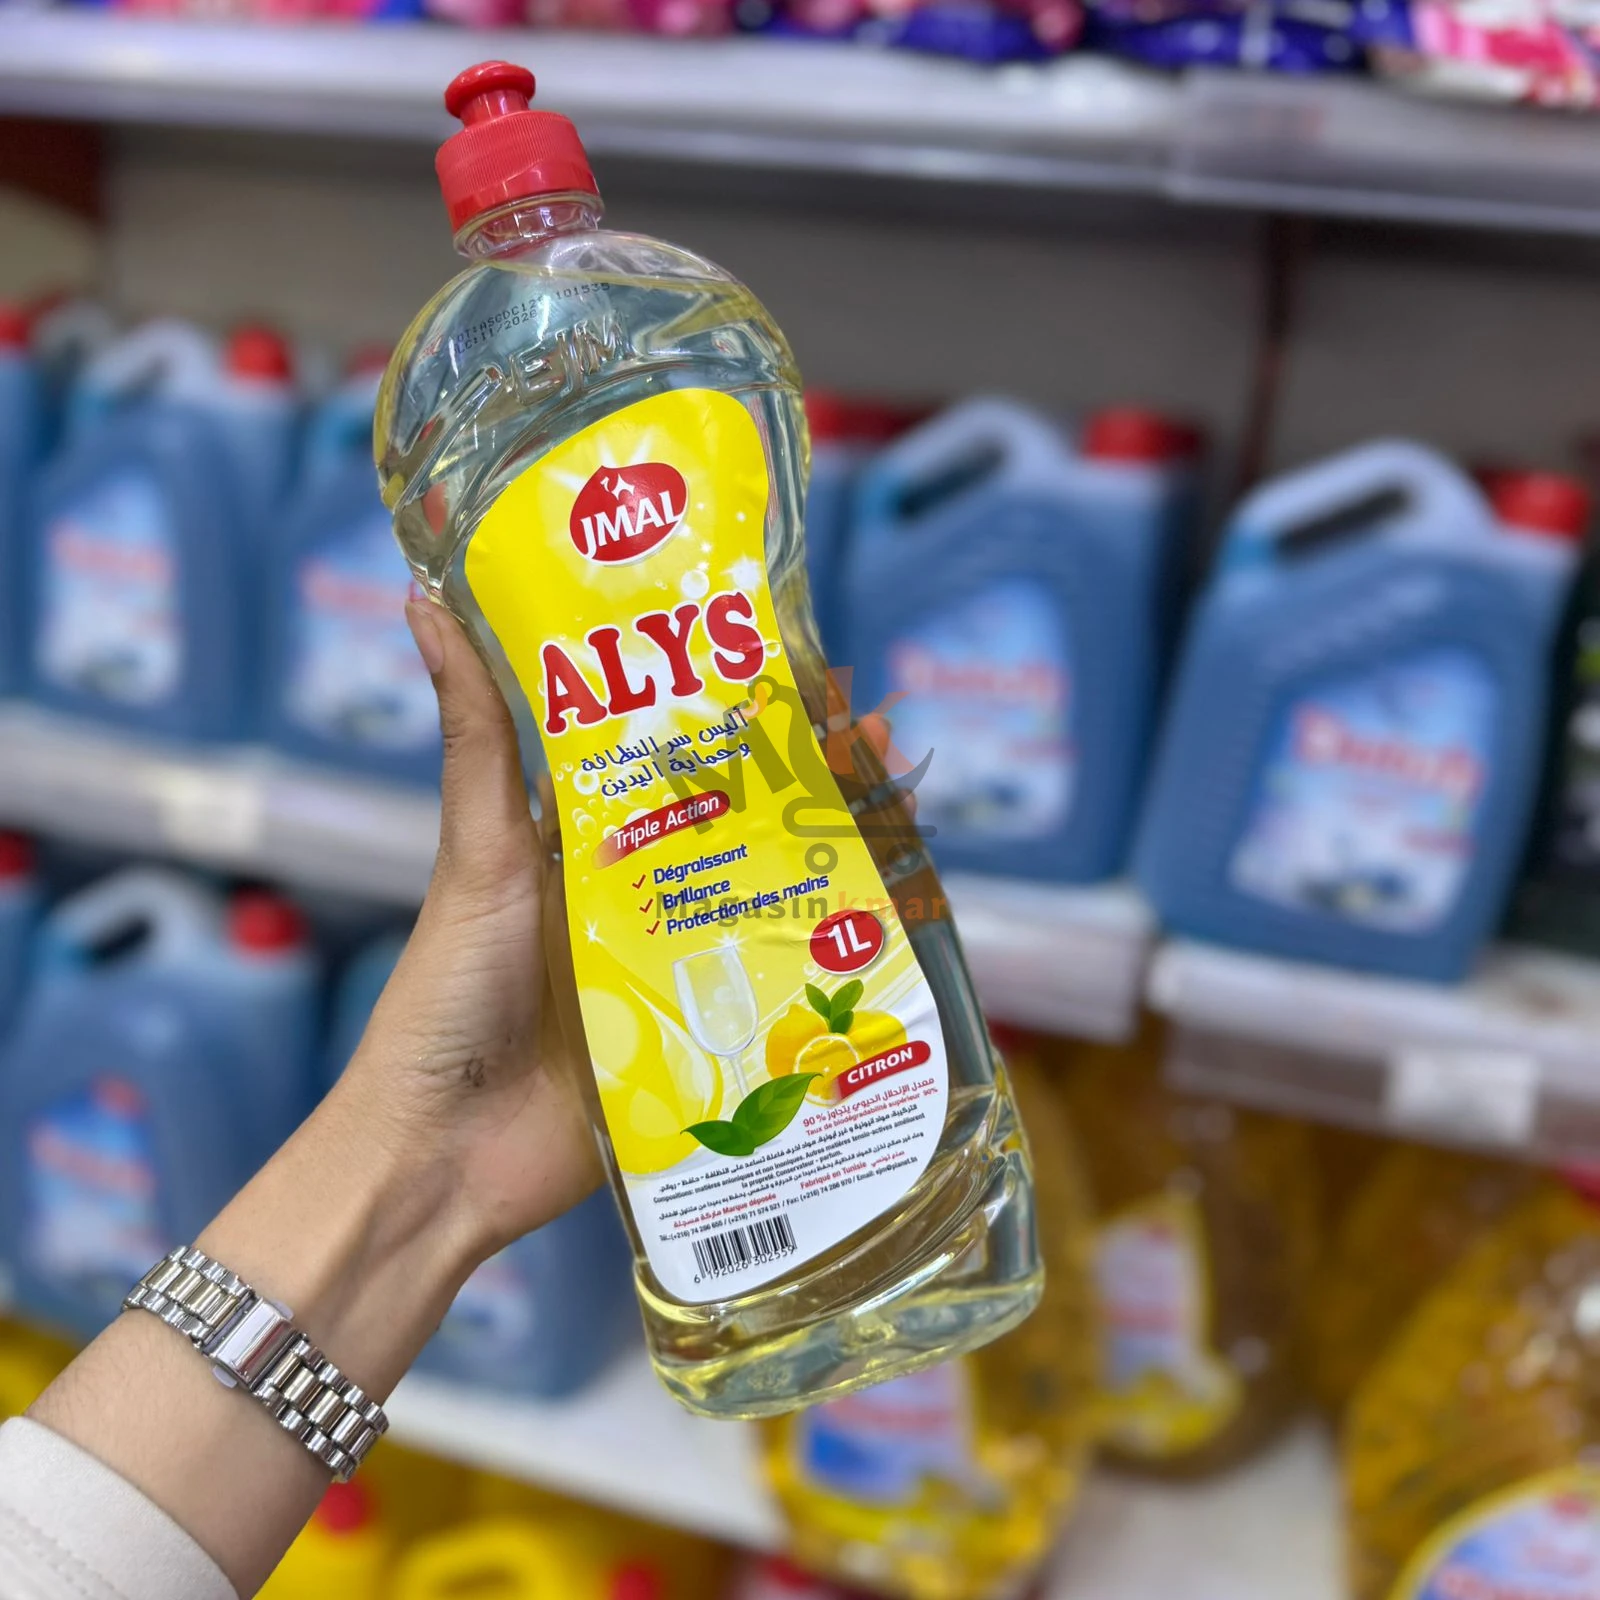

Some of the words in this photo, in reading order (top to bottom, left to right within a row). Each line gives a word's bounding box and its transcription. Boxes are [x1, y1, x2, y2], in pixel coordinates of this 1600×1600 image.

[556, 283, 611, 299] 101535
[454, 309, 538, 354] LC:11/2026
[581, 490, 683, 558] JMAL
[543, 592, 764, 734] ALYS
[698, 706, 748, 742] أليس
[581, 736, 660, 772] النظافة
[669, 743, 750, 773] وحماية
[601, 761, 664, 796] اليدين
[613, 820, 660, 849] Triple
[665, 796, 719, 829] Action
[653, 844, 747, 884] Dégraissant
[662, 880, 730, 909] Brillance
[667, 901, 749, 935] Protection
[752, 892, 780, 910] des
[783, 875, 829, 900] mains
[828, 919, 872, 958] 1L
[847, 1047, 913, 1084] CITRON
[852, 1094, 881, 1111] الحيوي
[911, 1078, 934, 1091] معدل
[802, 1116, 815, 1127] 90
[805, 1127, 822, 1136] Taux
[833, 1103, 887, 1126] biodégradabilité
[888, 1093, 920, 1107] supérieur
[922, 1087, 938, 1096] 90%
[826, 1105, 851, 1120] يتجاوز
[754, 1168, 762, 1176] et
[762, 1165, 774, 1173] non
[805, 1147, 825, 1158] Autres
[894, 1112, 925, 1127] améliorent
[775, 1160, 814, 1177] Conservateur
[819, 1150, 842, 1163] parfum.
[800, 1173, 831, 1189] Fabriqué
[831, 1170, 841, 1178] en
[841, 1162, 866, 1174] Tunisie
[690, 1227, 699, 1235] 74
[728, 1212, 748, 1224] (+216)
[747, 1209, 756, 1218] 71
[799, 1189, 820, 1201] (+216)
[700, 1210, 721, 1221] ماركة
[722, 1202, 747, 1214] Marque
[748, 1193, 776, 1206] déposée
[673, 1217, 699, 1228] مسجلة
[693, 1273, 701, 1283] 6
[708, 1259, 749, 1279] 192026
[753, 1244, 797, 1266] 302559
